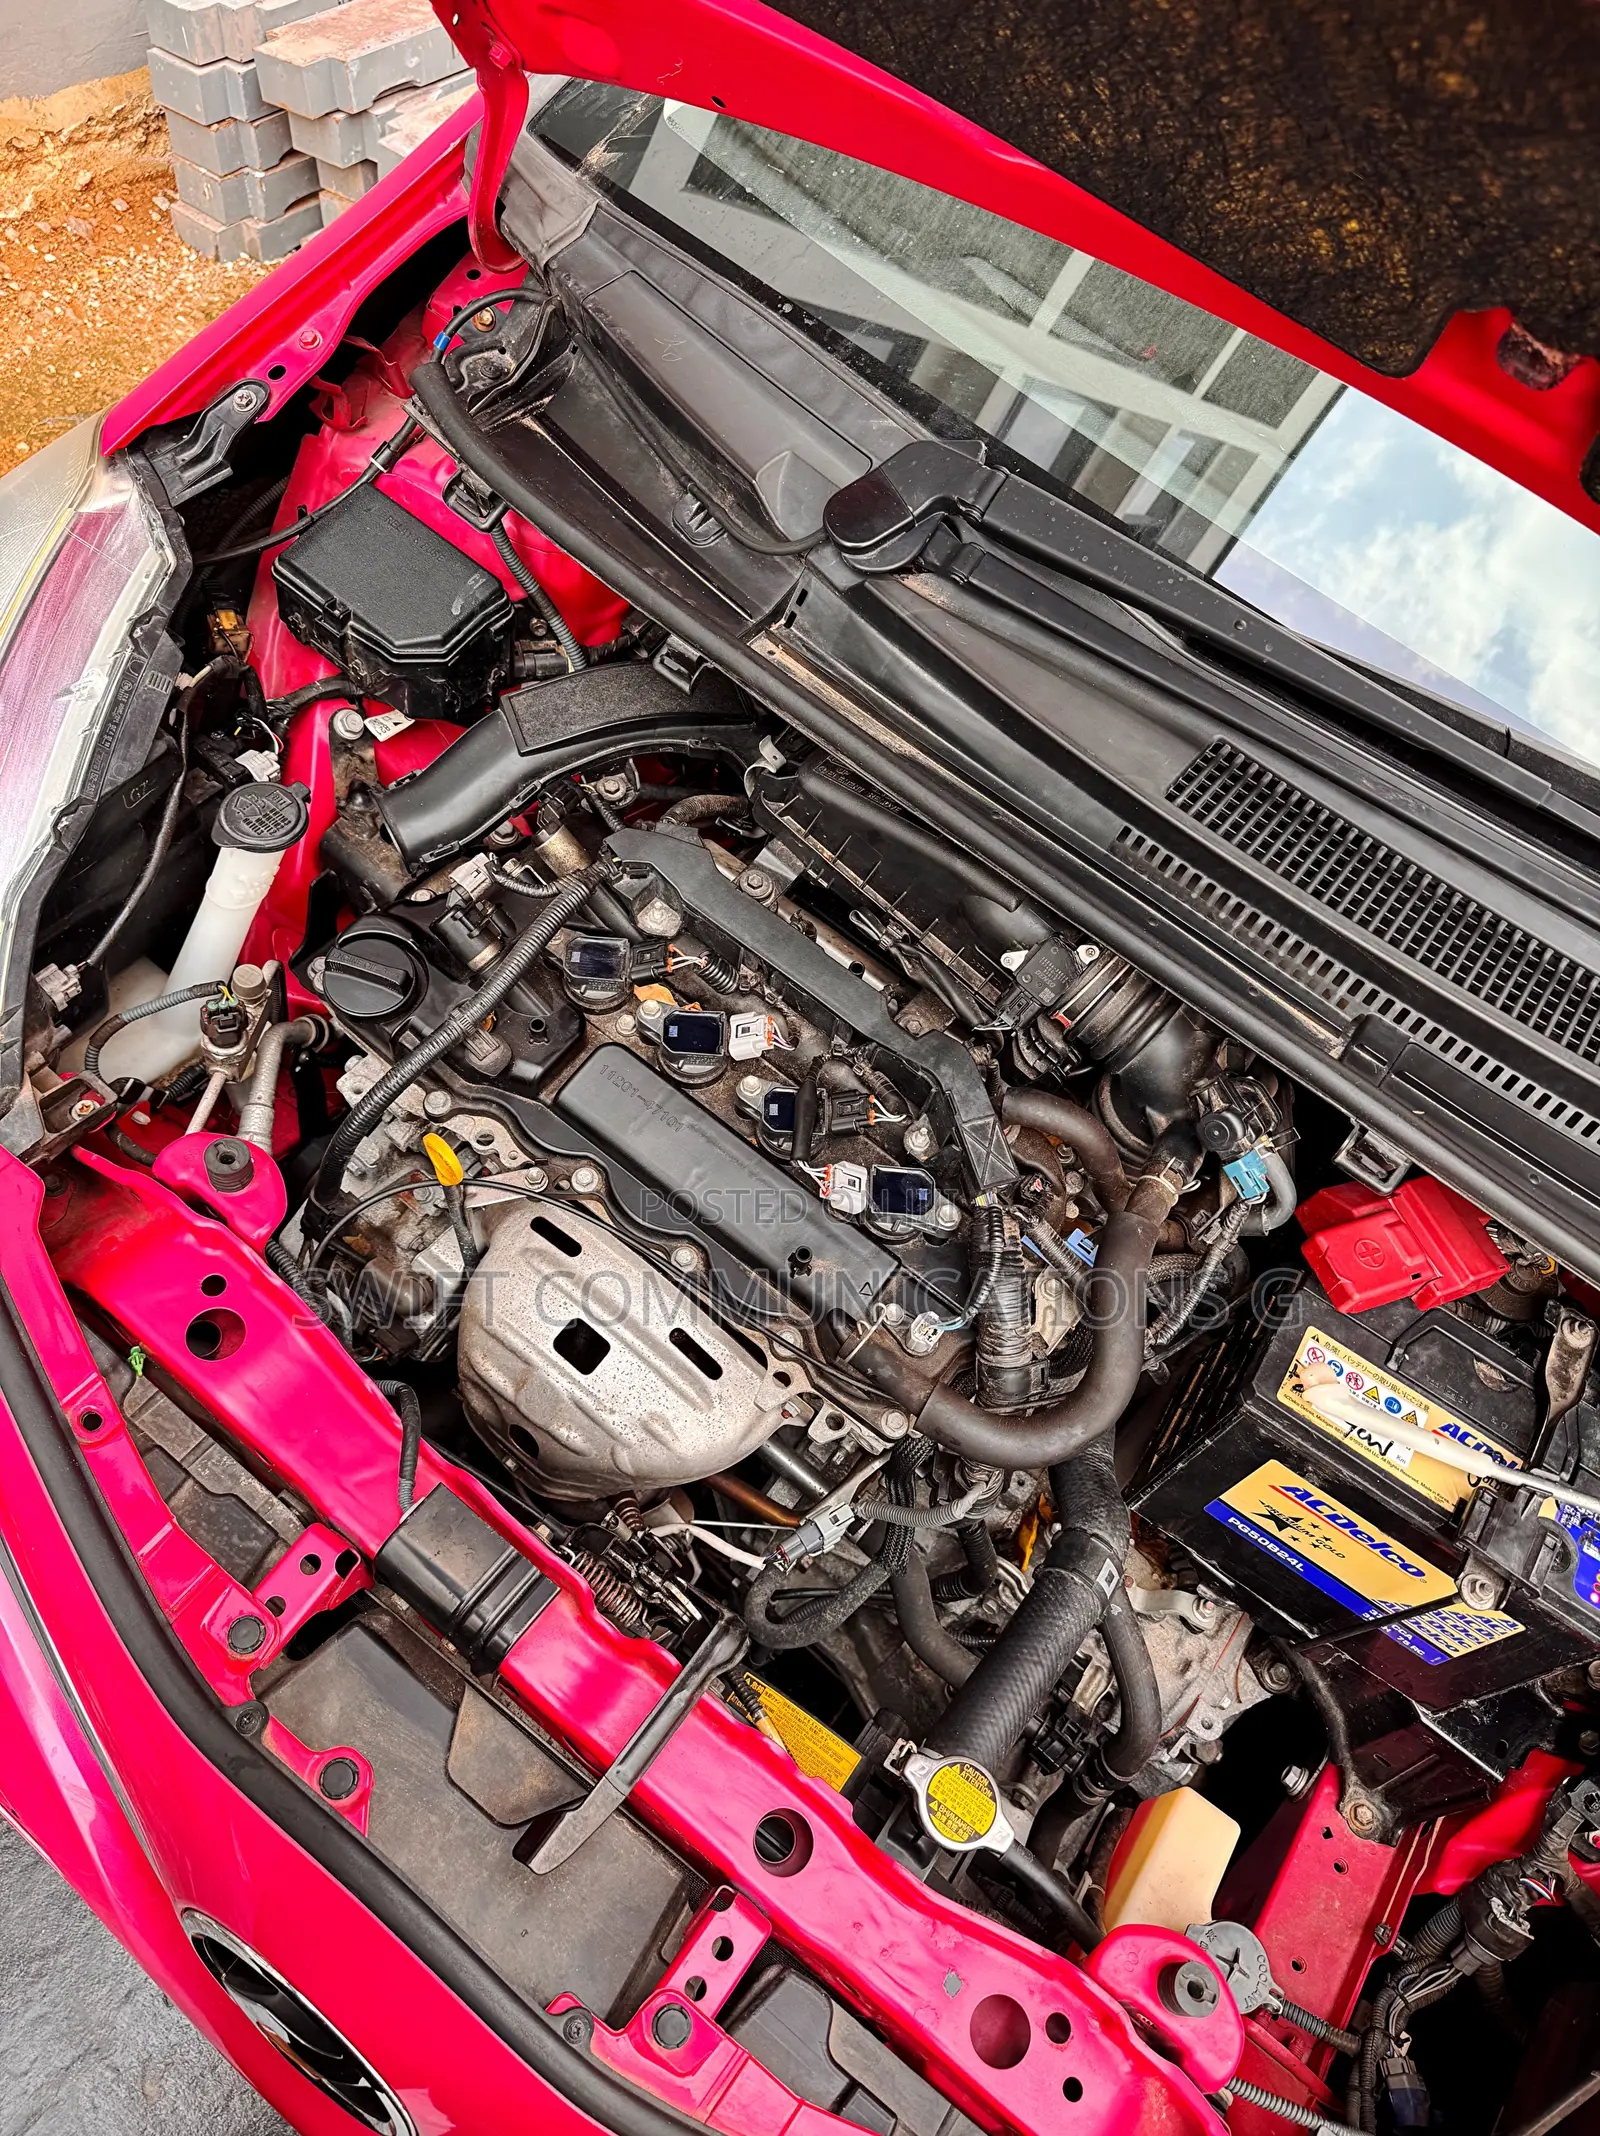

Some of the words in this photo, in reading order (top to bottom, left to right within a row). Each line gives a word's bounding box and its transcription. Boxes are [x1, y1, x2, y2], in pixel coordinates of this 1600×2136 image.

[1034, 969, 1056, 988] DENSO
[600, 1064, 685, 1133] 11201-47101
[1227, 1516, 1304, 1572] PG50B24L
[1264, 1504, 1316, 1538] PREMIUM
[1315, 1538, 1346, 1559] GOLD
[1279, 1485, 1425, 1577] ACDelco
[1391, 1624, 1413, 1641] CCA
[1410, 1645, 1425, 1656] RC
[959, 1769, 993, 1797] ATTENTION
[962, 1763, 990, 1786] CAUTION
[1245, 1954, 1269, 2009] COOLANT
